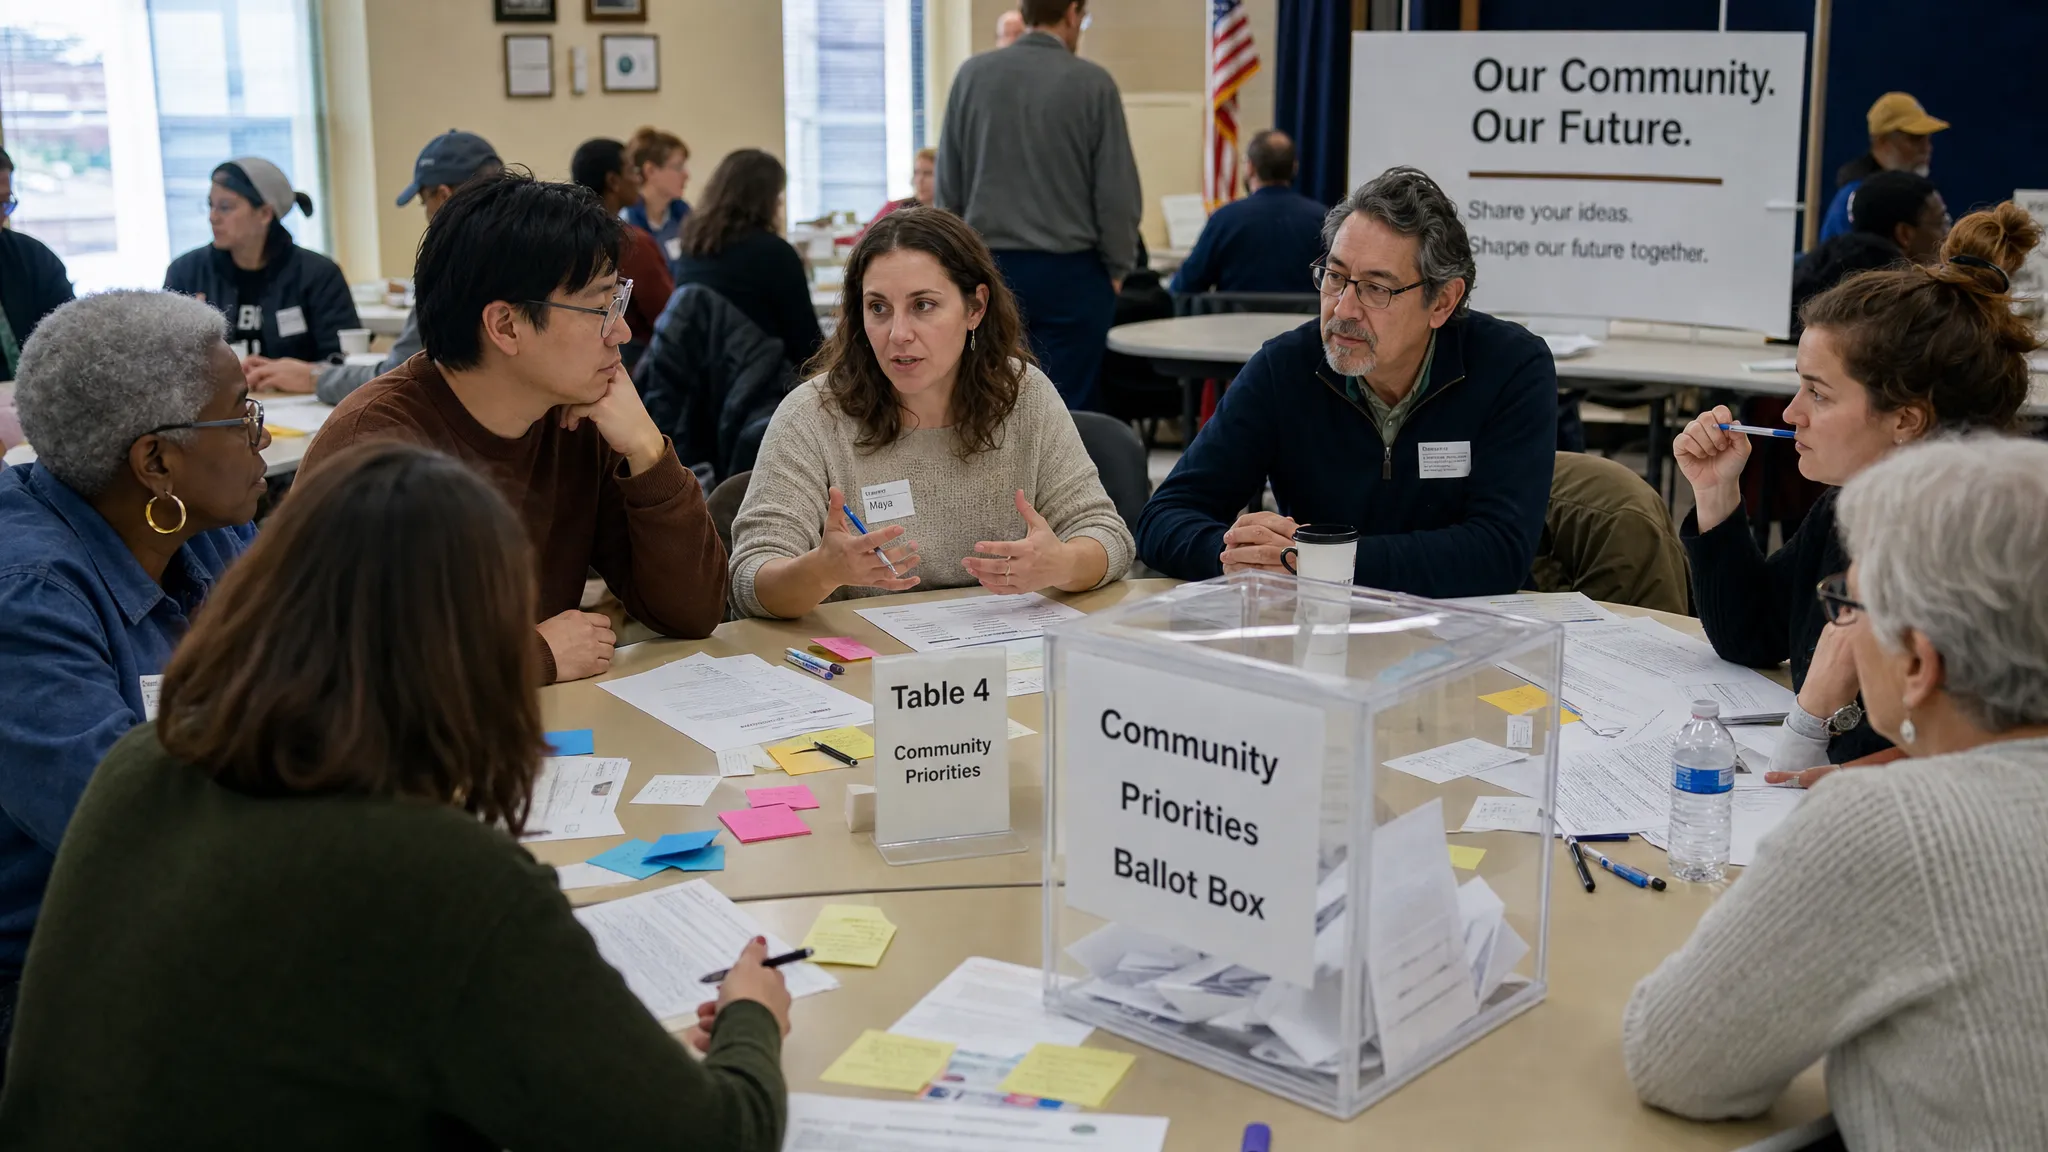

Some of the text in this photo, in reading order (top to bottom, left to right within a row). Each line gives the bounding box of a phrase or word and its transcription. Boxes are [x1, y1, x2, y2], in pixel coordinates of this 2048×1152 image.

[1473, 58, 1775, 104] Our Community.
[1472, 108, 1691, 146] Our Future.
[1468, 200, 1632, 225] Share your ideas.
[1470, 236, 1708, 266] Shape our future together.
[869, 500, 894, 511] Maya
[890, 677, 990, 710] Table 4
[894, 738, 992, 761] Community
[1100, 709, 1279, 785] Community
[906, 764, 981, 784] Priorities
[1121, 780, 1260, 847] Priorities
[1114, 847, 1265, 920] Ballot Box
